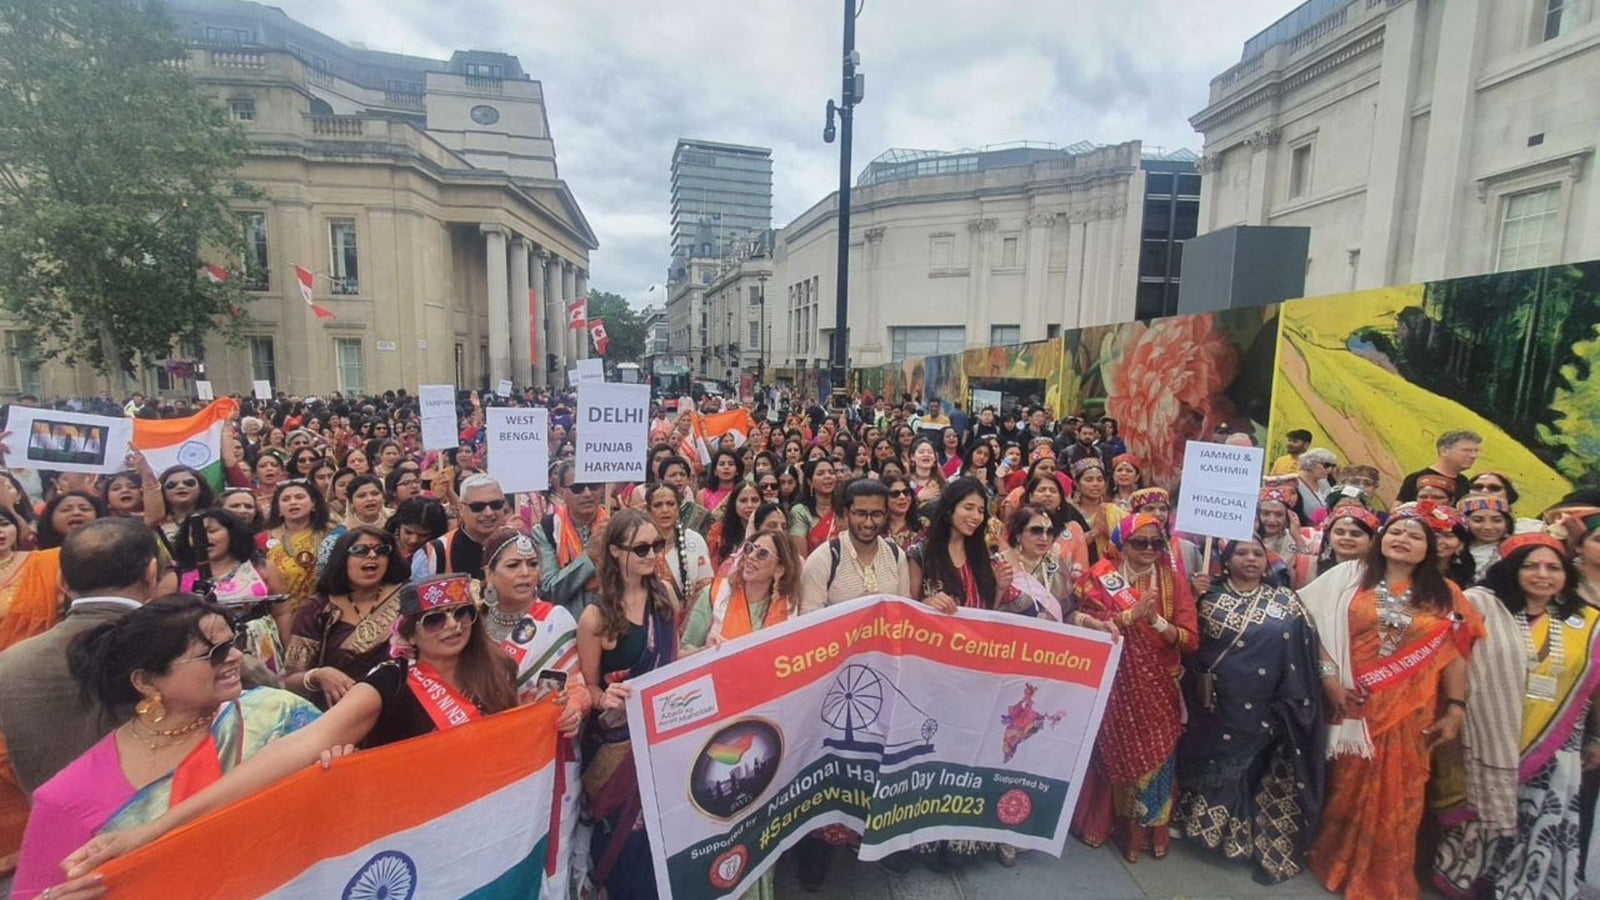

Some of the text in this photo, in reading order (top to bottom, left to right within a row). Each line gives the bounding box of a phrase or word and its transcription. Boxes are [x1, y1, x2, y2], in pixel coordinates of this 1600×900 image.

[505, 415, 535, 425] WEST
[588, 406, 644, 424] DELHI
[499, 431, 541, 441] BENGAL
[585, 442, 633, 453] PUNJAB
[1199, 449, 1252, 462] JAMMU &
[584, 461, 643, 473] HARYANA
[1199, 463, 1249, 476] KASHMIR
[1192, 494, 1248, 509] HIMACHAL
[1194, 508, 1242, 521] PRADESH
[773, 641, 840, 679] Saree
[950, 632, 1016, 660] Central
[1021, 641, 1092, 671] London
[1400, 645, 1432, 669] WOMEN
[1388, 661, 1402, 675] IN
[436, 695, 455, 711] IN
[767, 760, 840, 816] National
[911, 769, 936, 791] Day
[939, 768, 983, 789] India
[993, 773, 1050, 792] Supported by
[690, 824, 744, 860] Supported
